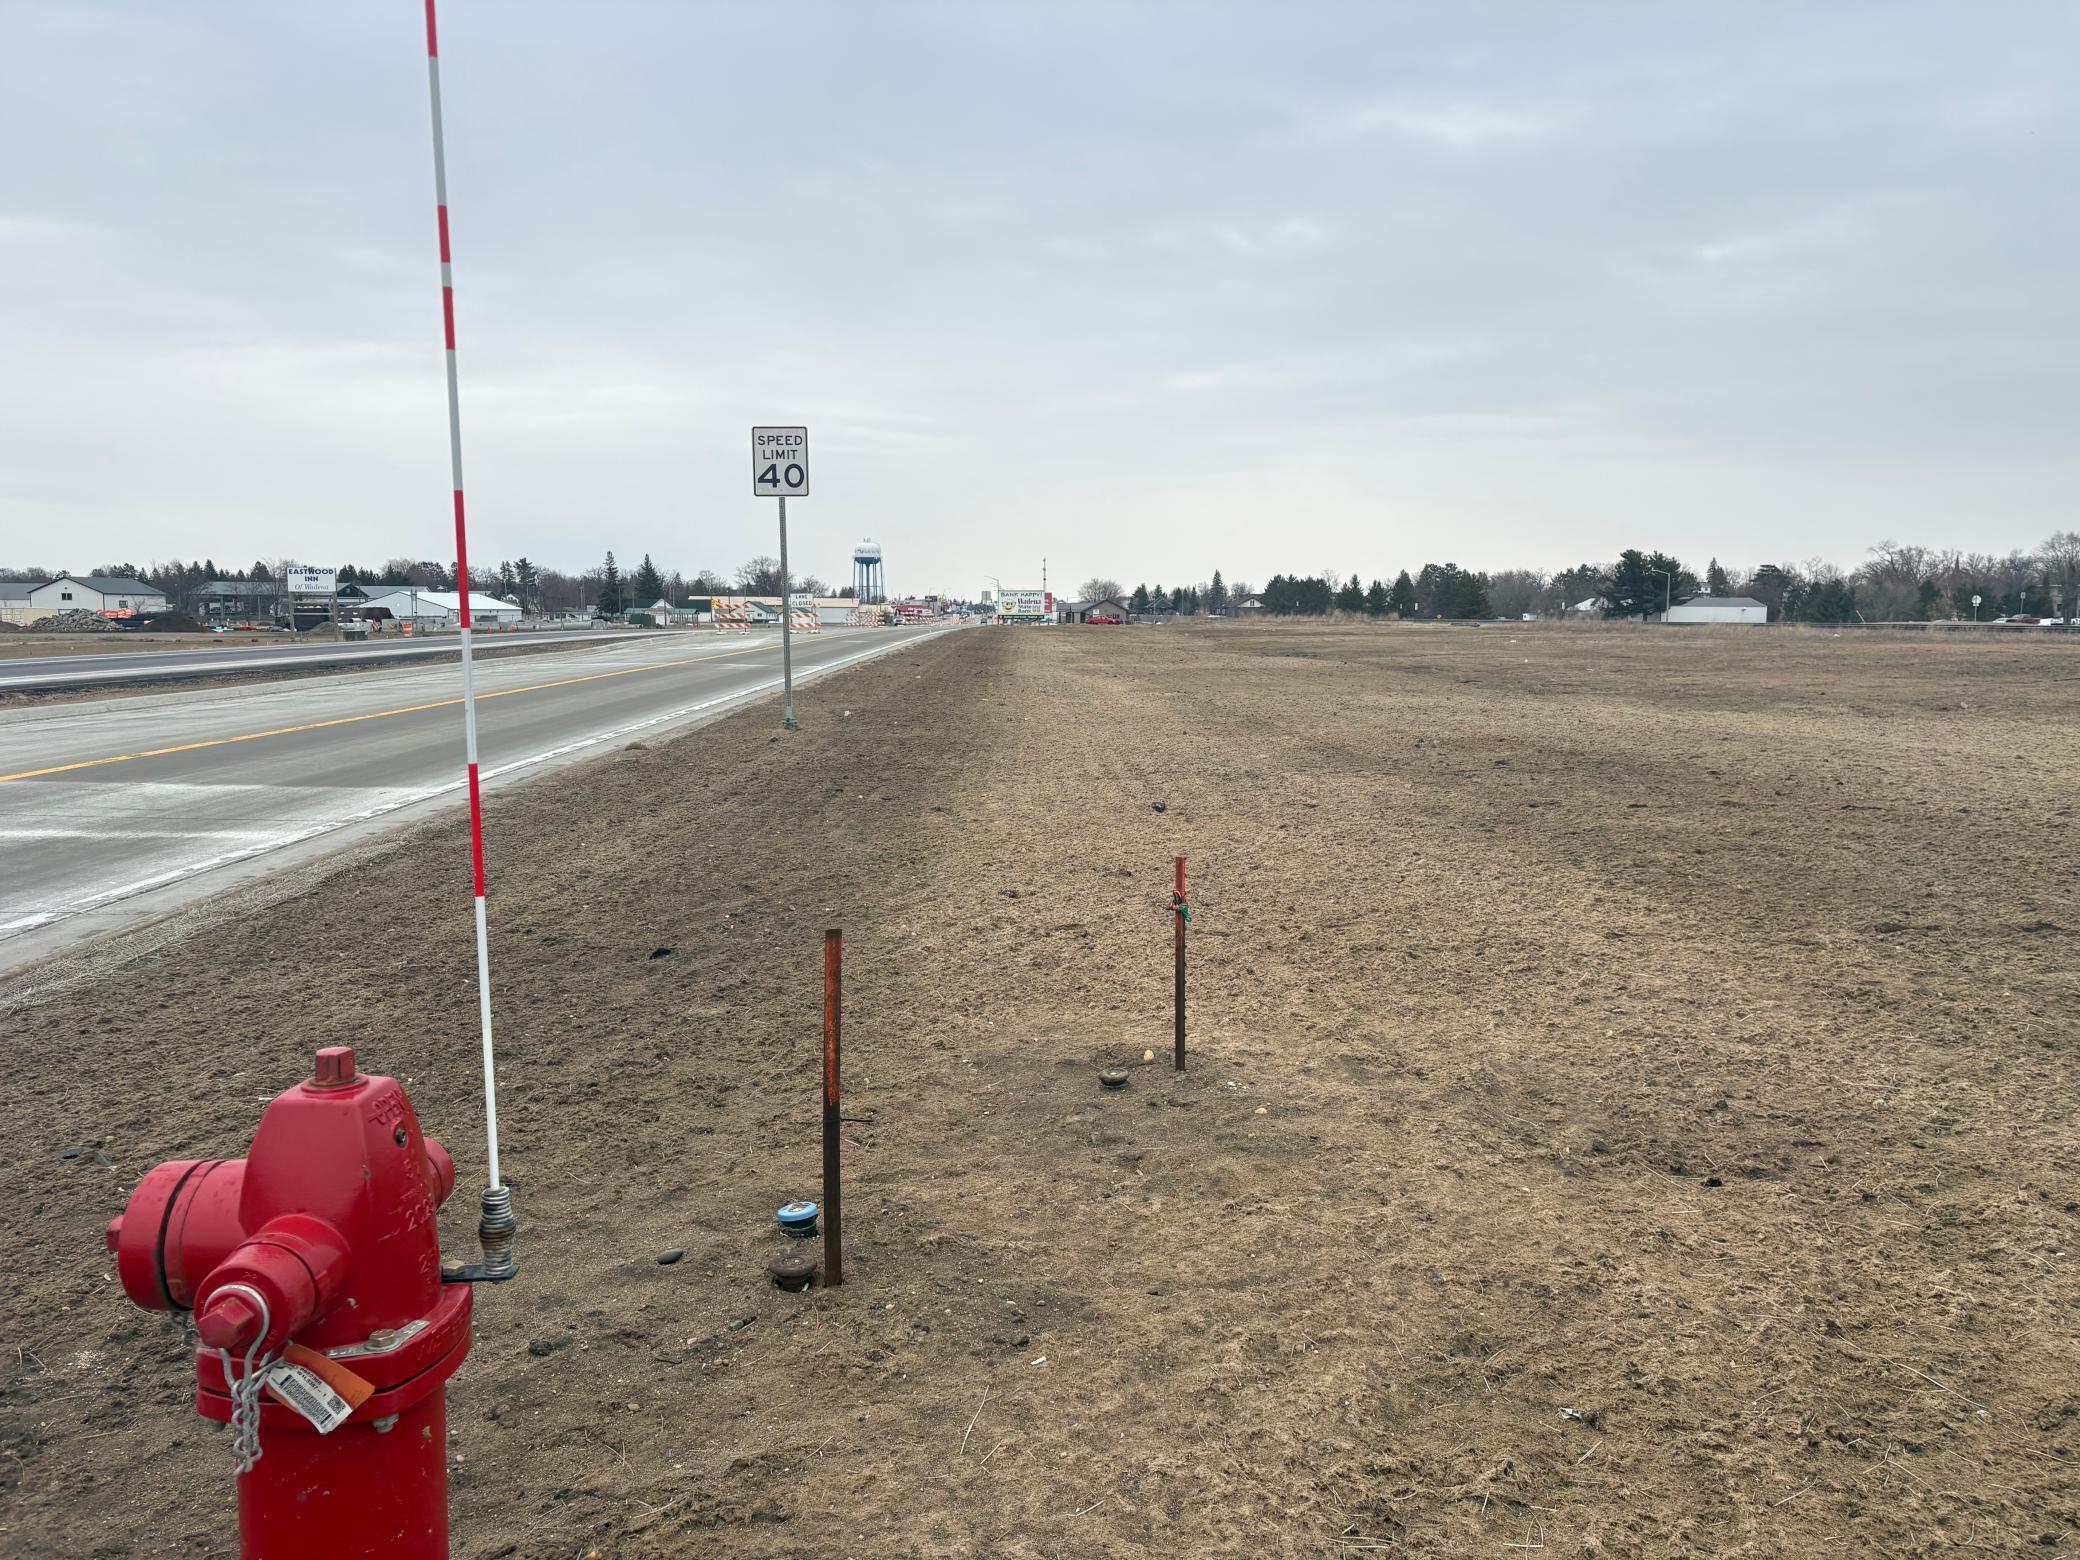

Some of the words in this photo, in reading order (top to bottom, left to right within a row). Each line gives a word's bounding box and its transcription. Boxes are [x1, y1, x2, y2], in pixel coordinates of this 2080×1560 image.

[758, 435, 803, 446] SPEED
[763, 449, 798, 460] LIMIT
[757, 463, 805, 488] 40
